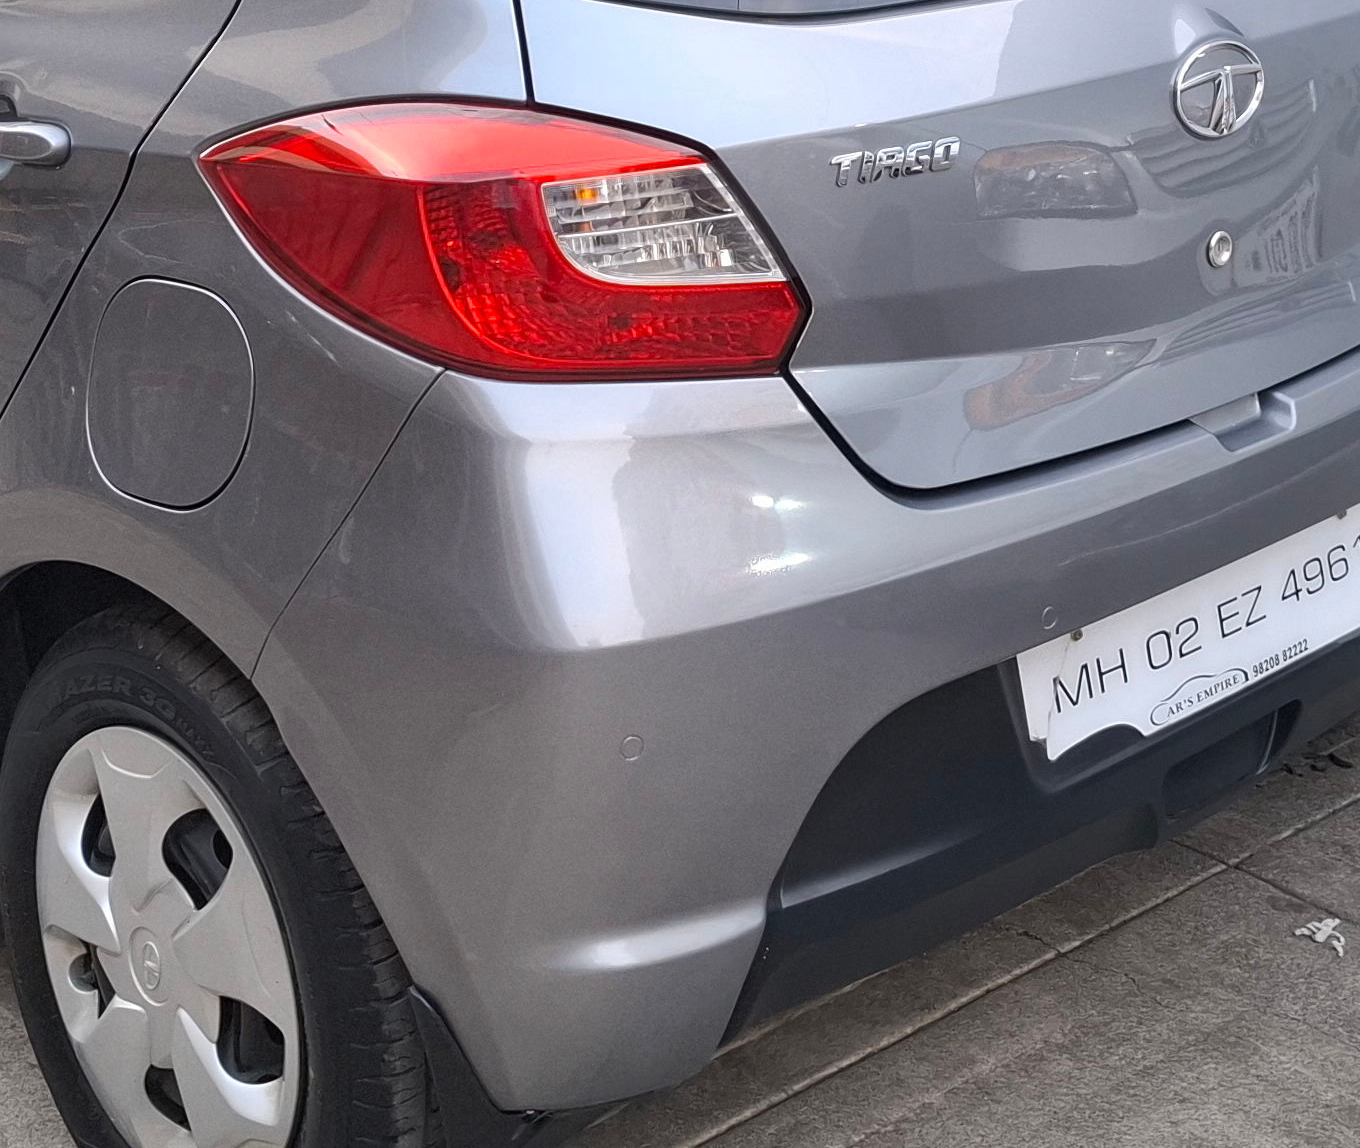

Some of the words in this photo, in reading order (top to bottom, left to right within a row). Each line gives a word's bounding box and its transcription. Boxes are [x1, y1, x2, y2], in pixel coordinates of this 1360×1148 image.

[830, 136, 961, 187] TIAGO
[1052, 648, 1130, 714] MH
[1145, 616, 1204, 671] 02
[1216, 585, 1267, 640] EZ
[1196, 674, 1241, 704] EMPIRE
[1252, 654, 1281, 678] 98208
[1282, 638, 1309, 664] 82222
